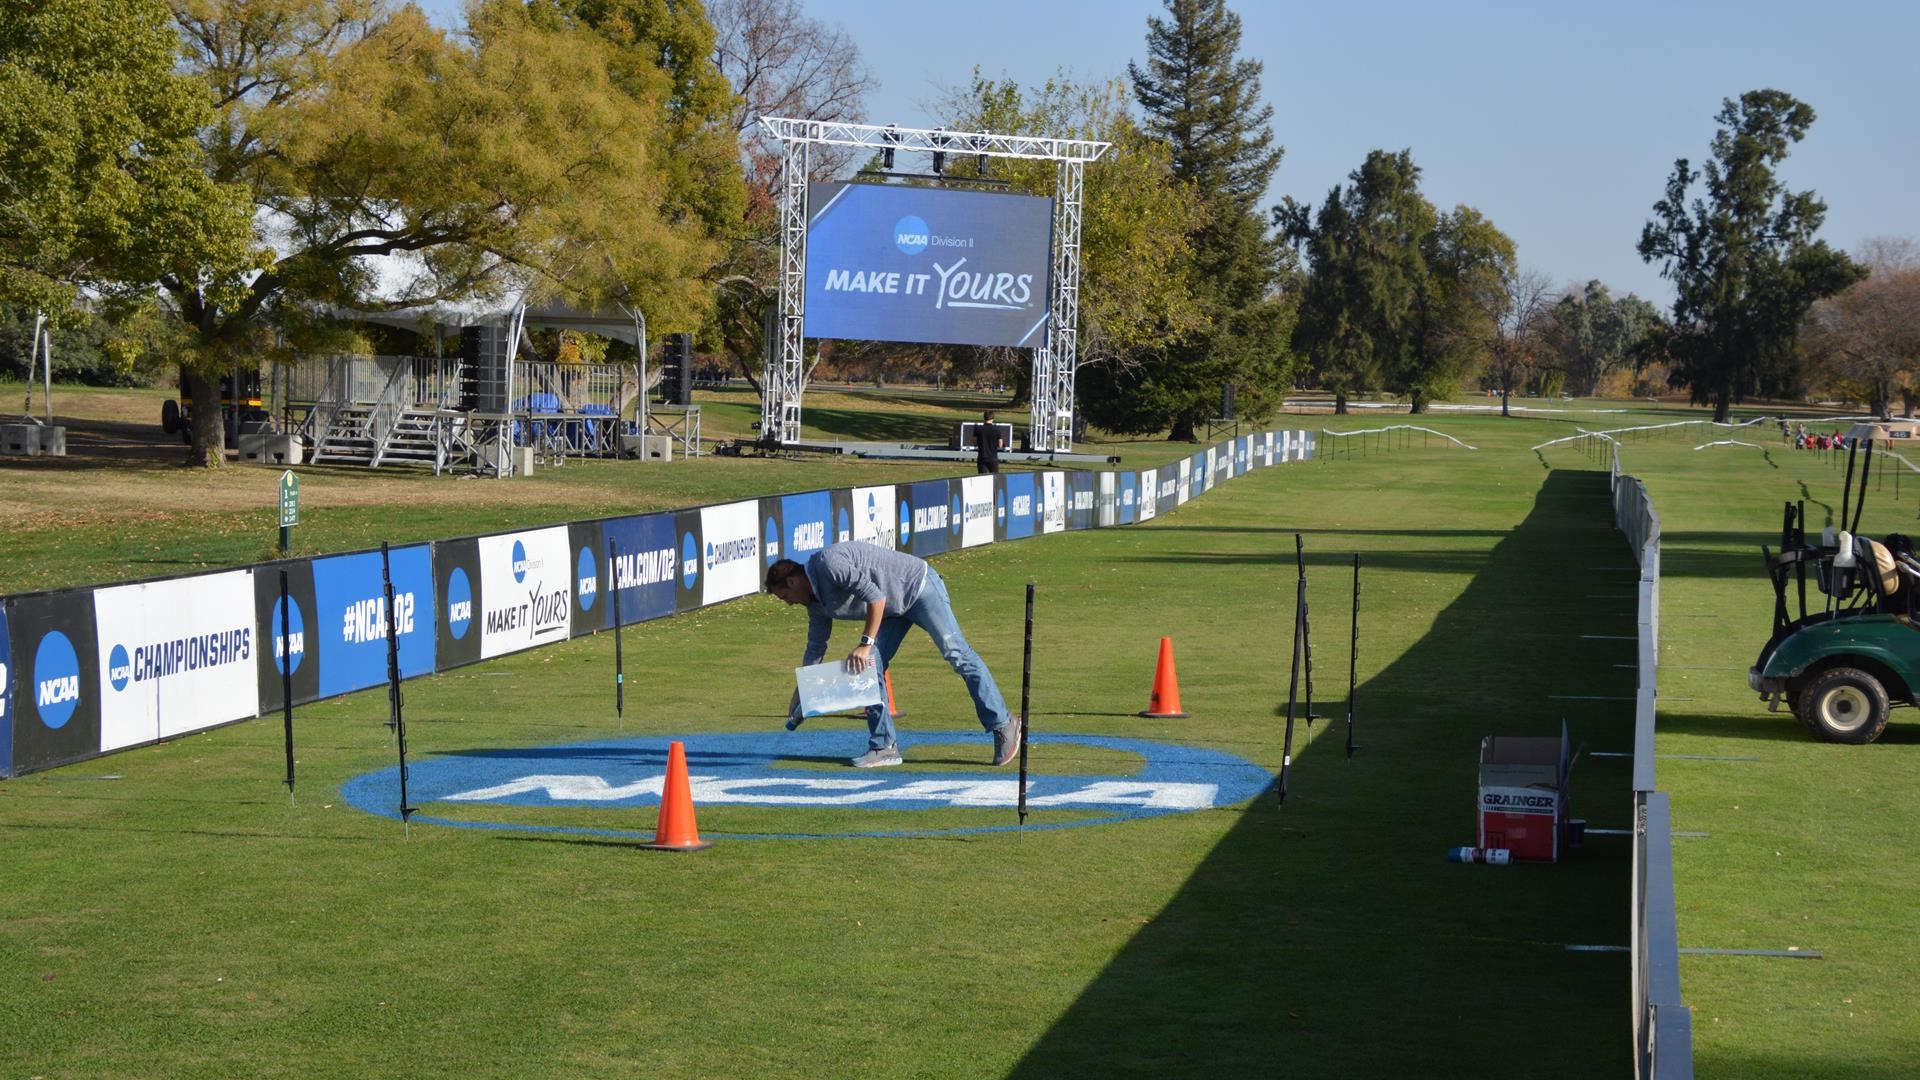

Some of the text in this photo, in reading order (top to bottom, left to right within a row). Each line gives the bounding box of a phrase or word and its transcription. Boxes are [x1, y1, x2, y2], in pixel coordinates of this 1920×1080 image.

[897, 234, 975, 248] NCAA Division II
[825, 256, 1033, 310] MAKE IT YOURS
[715, 536, 756, 565] CHAMPIONSHIPS
[793, 521, 824, 551] #NCAAD2
[684, 558, 698, 577] NCAA
[579, 577, 597, 595] NCAA
[343, 592, 414, 643] #NCAD2
[450, 601, 471, 623] NCAA
[486, 580, 568, 640] MAKE IT YOURS
[111, 627, 250, 682] NCAA CHAMPIONSHIPS
[276, 632, 304, 658] NAA
[39, 675, 79, 707] NCAA
[438, 774, 1218, 809] NCAA
[1483, 794, 1553, 808] GRAINGER
